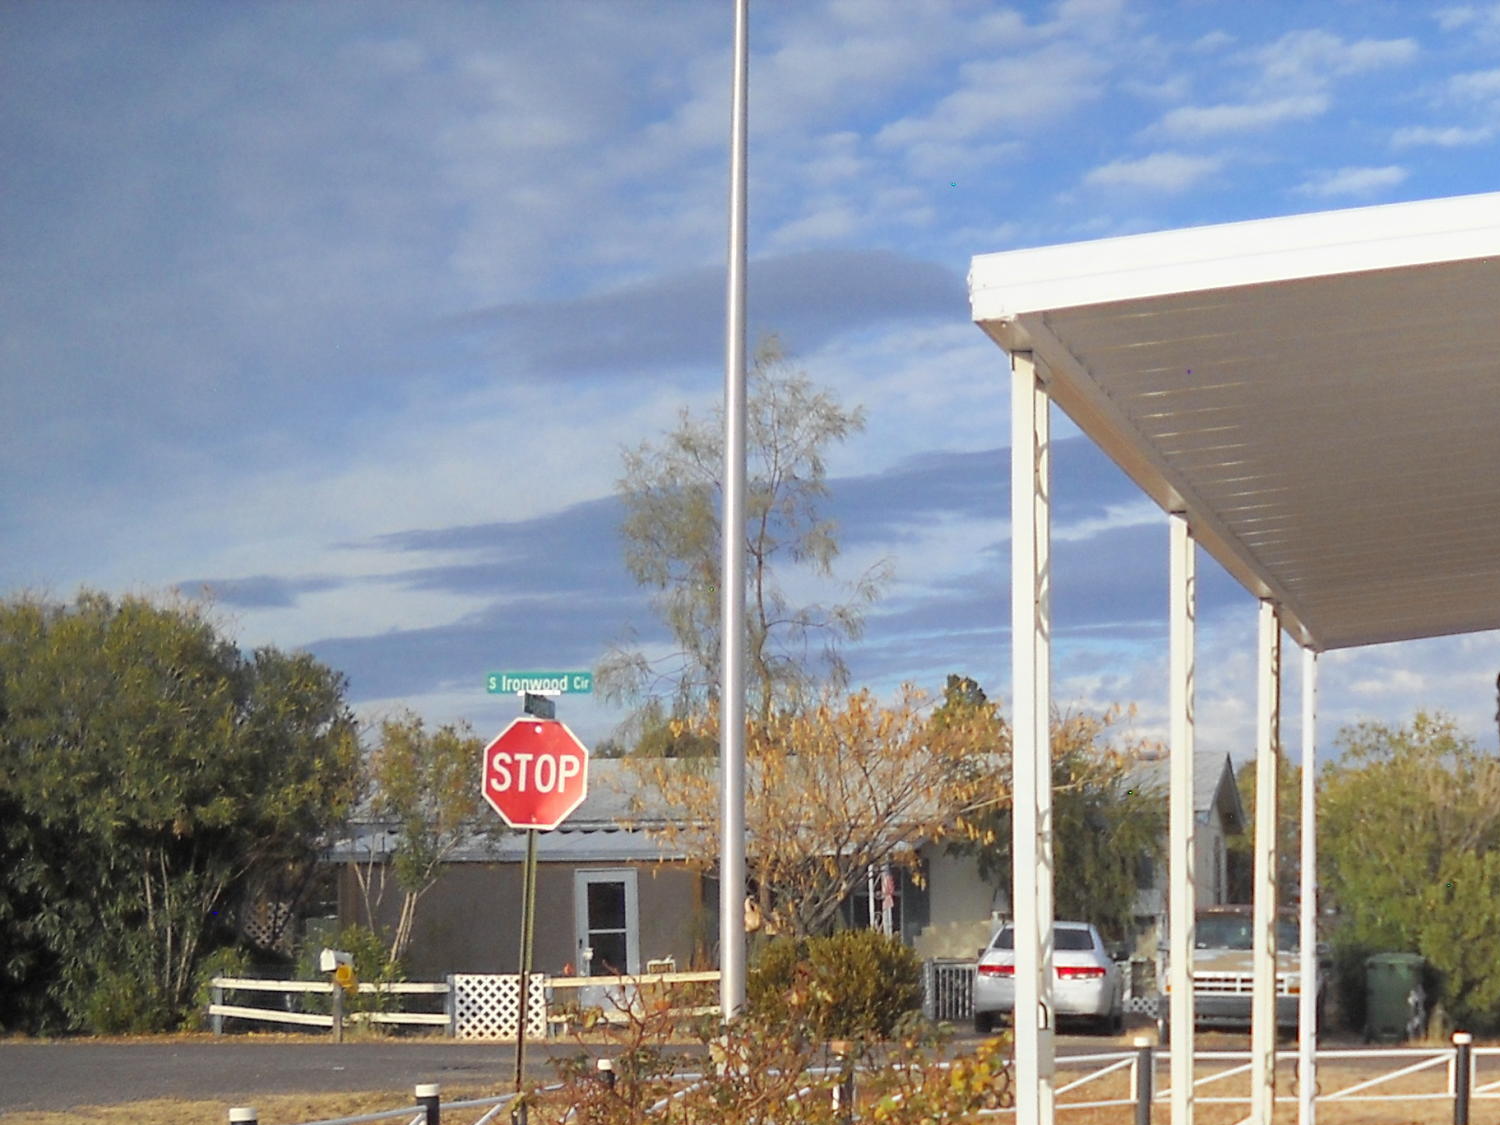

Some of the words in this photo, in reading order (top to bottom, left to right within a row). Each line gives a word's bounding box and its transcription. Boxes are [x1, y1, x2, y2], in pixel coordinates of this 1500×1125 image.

[489, 677, 497, 690] S
[502, 675, 569, 691] Ironwood
[573, 676, 590, 690] Cir
[490, 752, 580, 793] STOP
